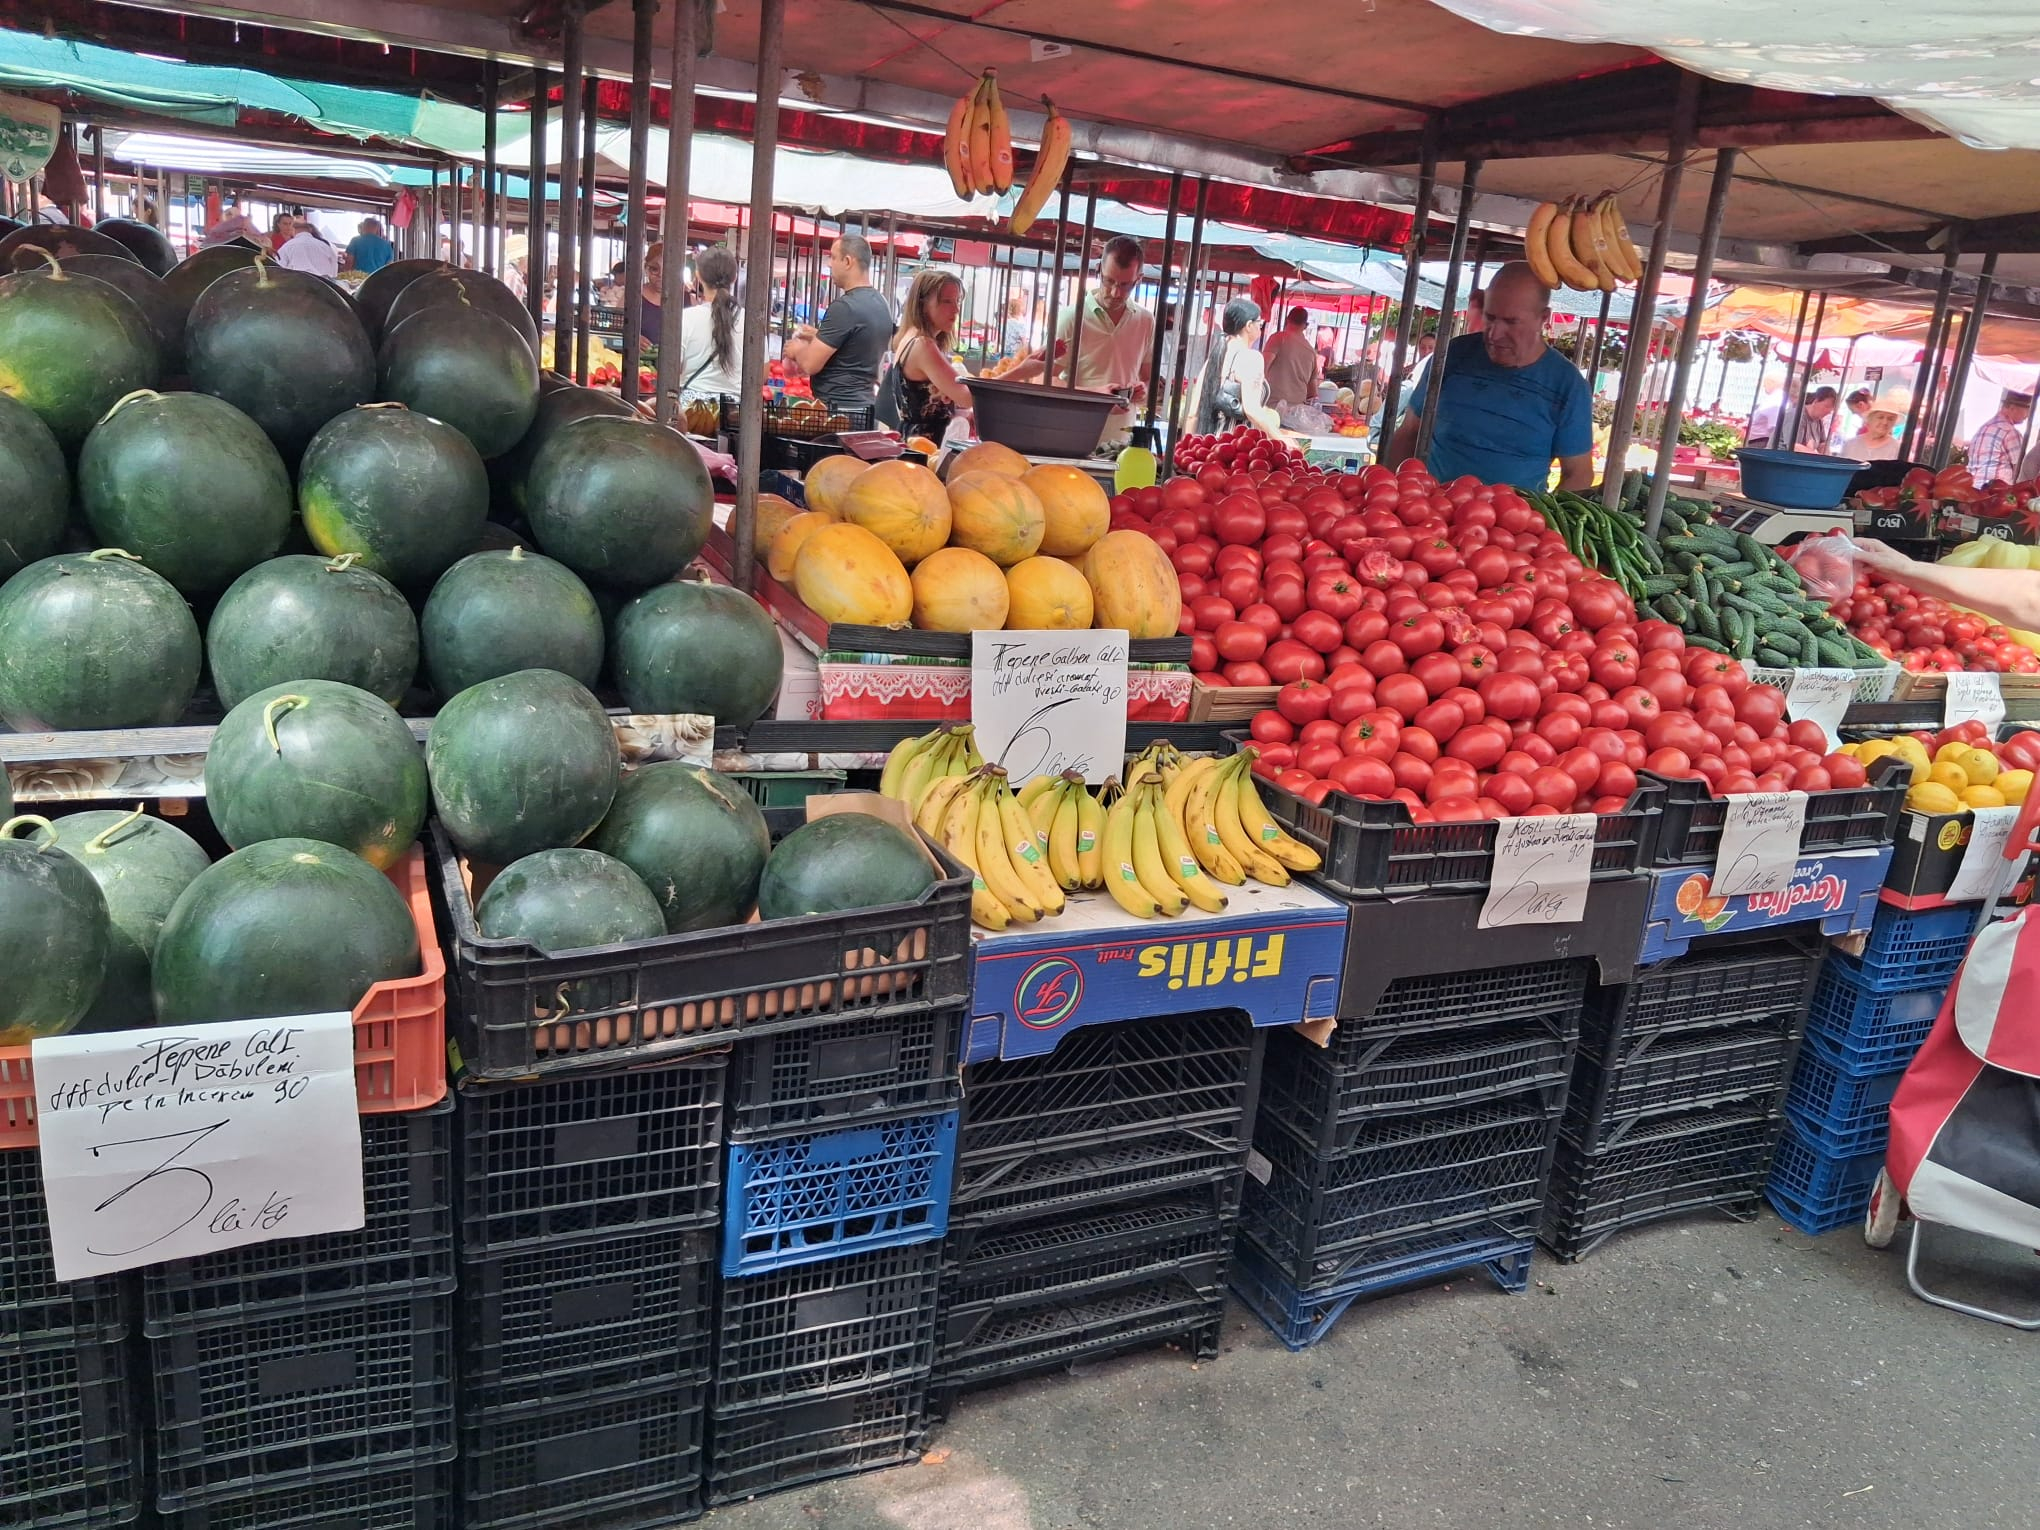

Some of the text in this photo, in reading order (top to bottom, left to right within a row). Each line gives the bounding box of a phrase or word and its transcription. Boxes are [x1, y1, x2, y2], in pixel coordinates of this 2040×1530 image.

[1877, 517, 1901, 529] CASI
[991, 643, 1051, 674] Pepene
[1051, 647, 1091, 666] Galben
[1720, 829, 1771, 896] 6
[1486, 852, 1554, 927] 6
[1747, 874, 1848, 918] Karellias
[1097, 947, 1135, 964] Fruit
[1137, 933, 1286, 990] Fiflis
[137, 1037, 231, 1086] Pepene
[86, 1118, 231, 1256] 3
